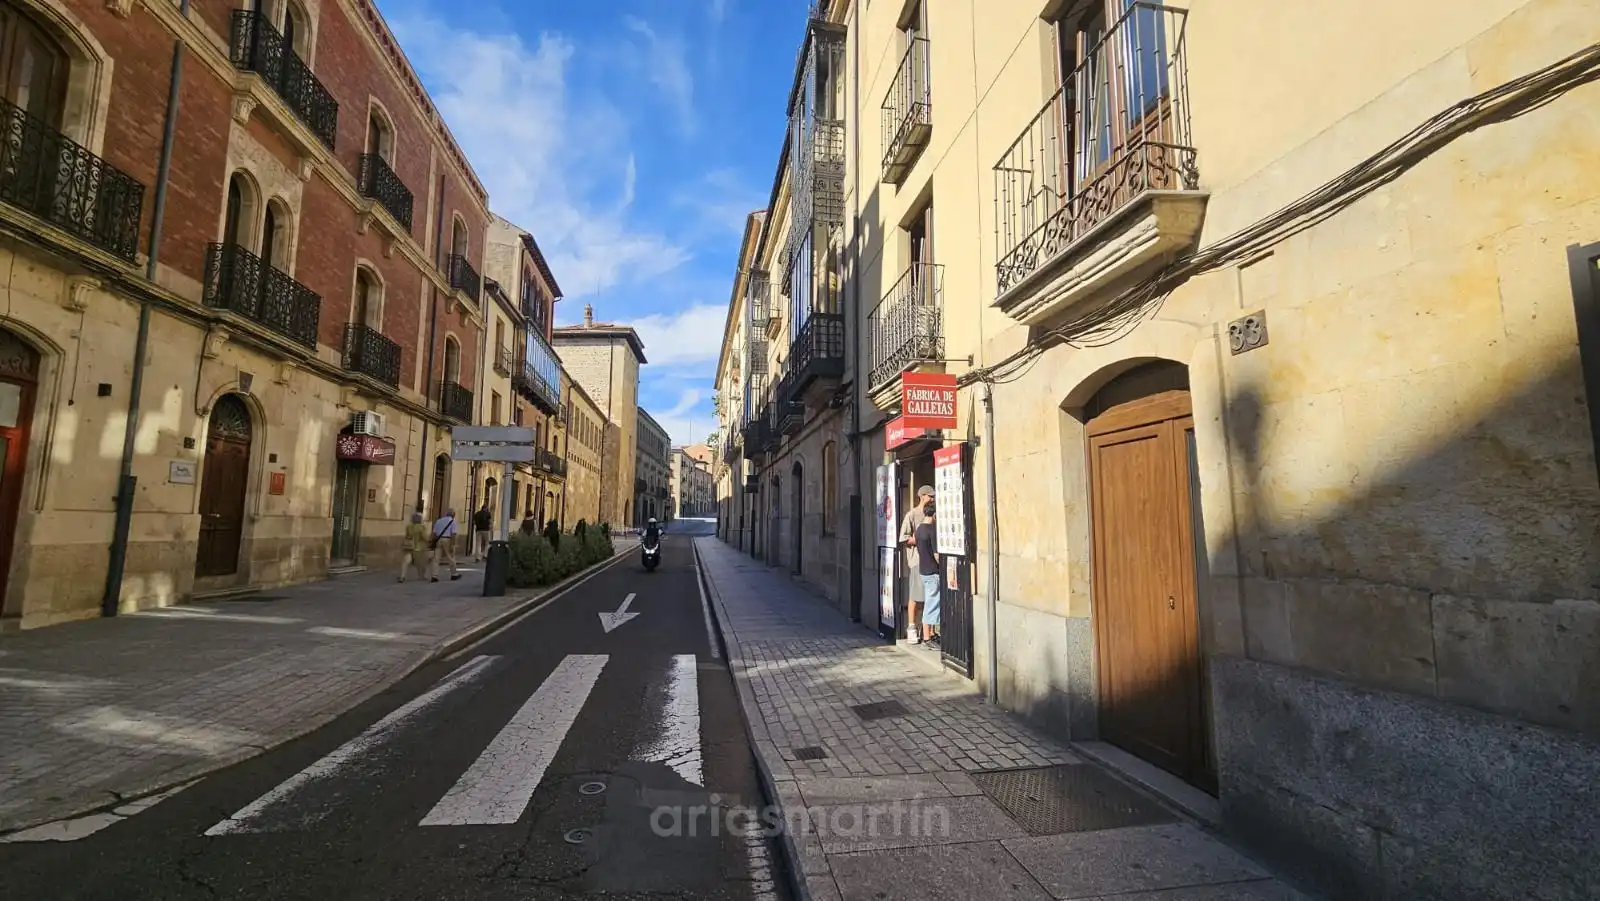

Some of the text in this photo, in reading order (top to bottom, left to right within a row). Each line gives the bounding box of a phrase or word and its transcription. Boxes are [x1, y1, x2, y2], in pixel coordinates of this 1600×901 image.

[907, 387, 953, 401] FÁBRICA DE
[908, 401, 953, 415] GALLETAS
